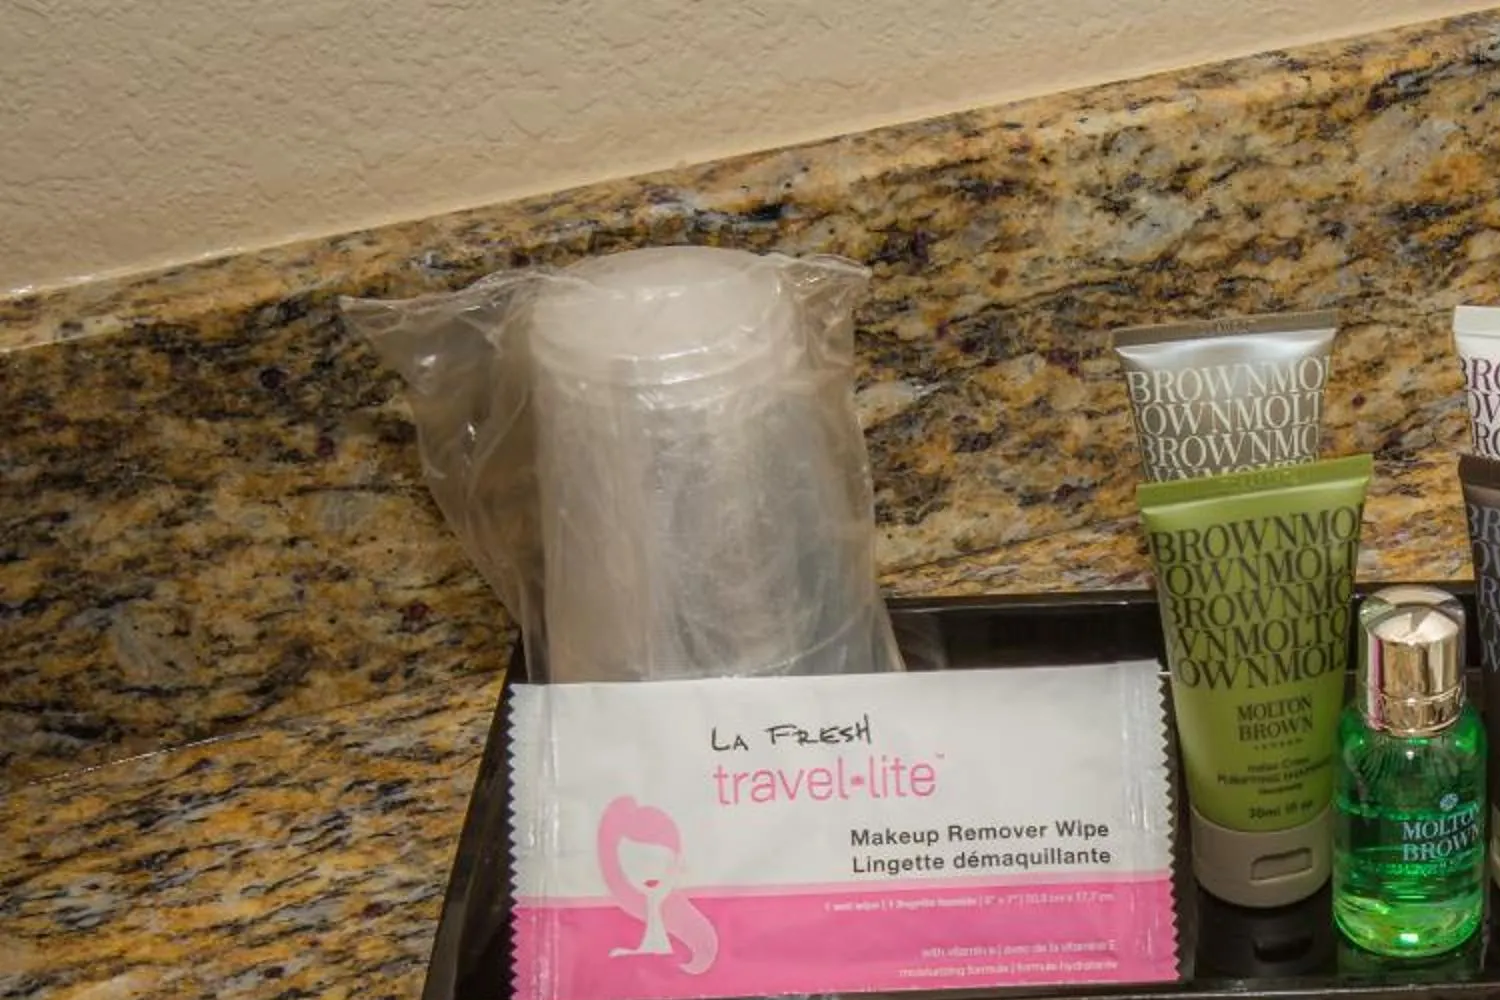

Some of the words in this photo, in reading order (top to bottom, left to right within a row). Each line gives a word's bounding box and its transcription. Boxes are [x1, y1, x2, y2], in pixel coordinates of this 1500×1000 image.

[1236, 695, 1313, 721] MOLTON
[711, 727, 749, 751] LA
[765, 713, 873, 745] FRESH
[1237, 716, 1314, 742] BROWN
[850, 827, 940, 847] Makeup
[947, 823, 1048, 843] Remover
[1055, 819, 1109, 841] Wipe
[853, 855, 945, 875] Lingette
[953, 847, 1112, 871] démaquillante
